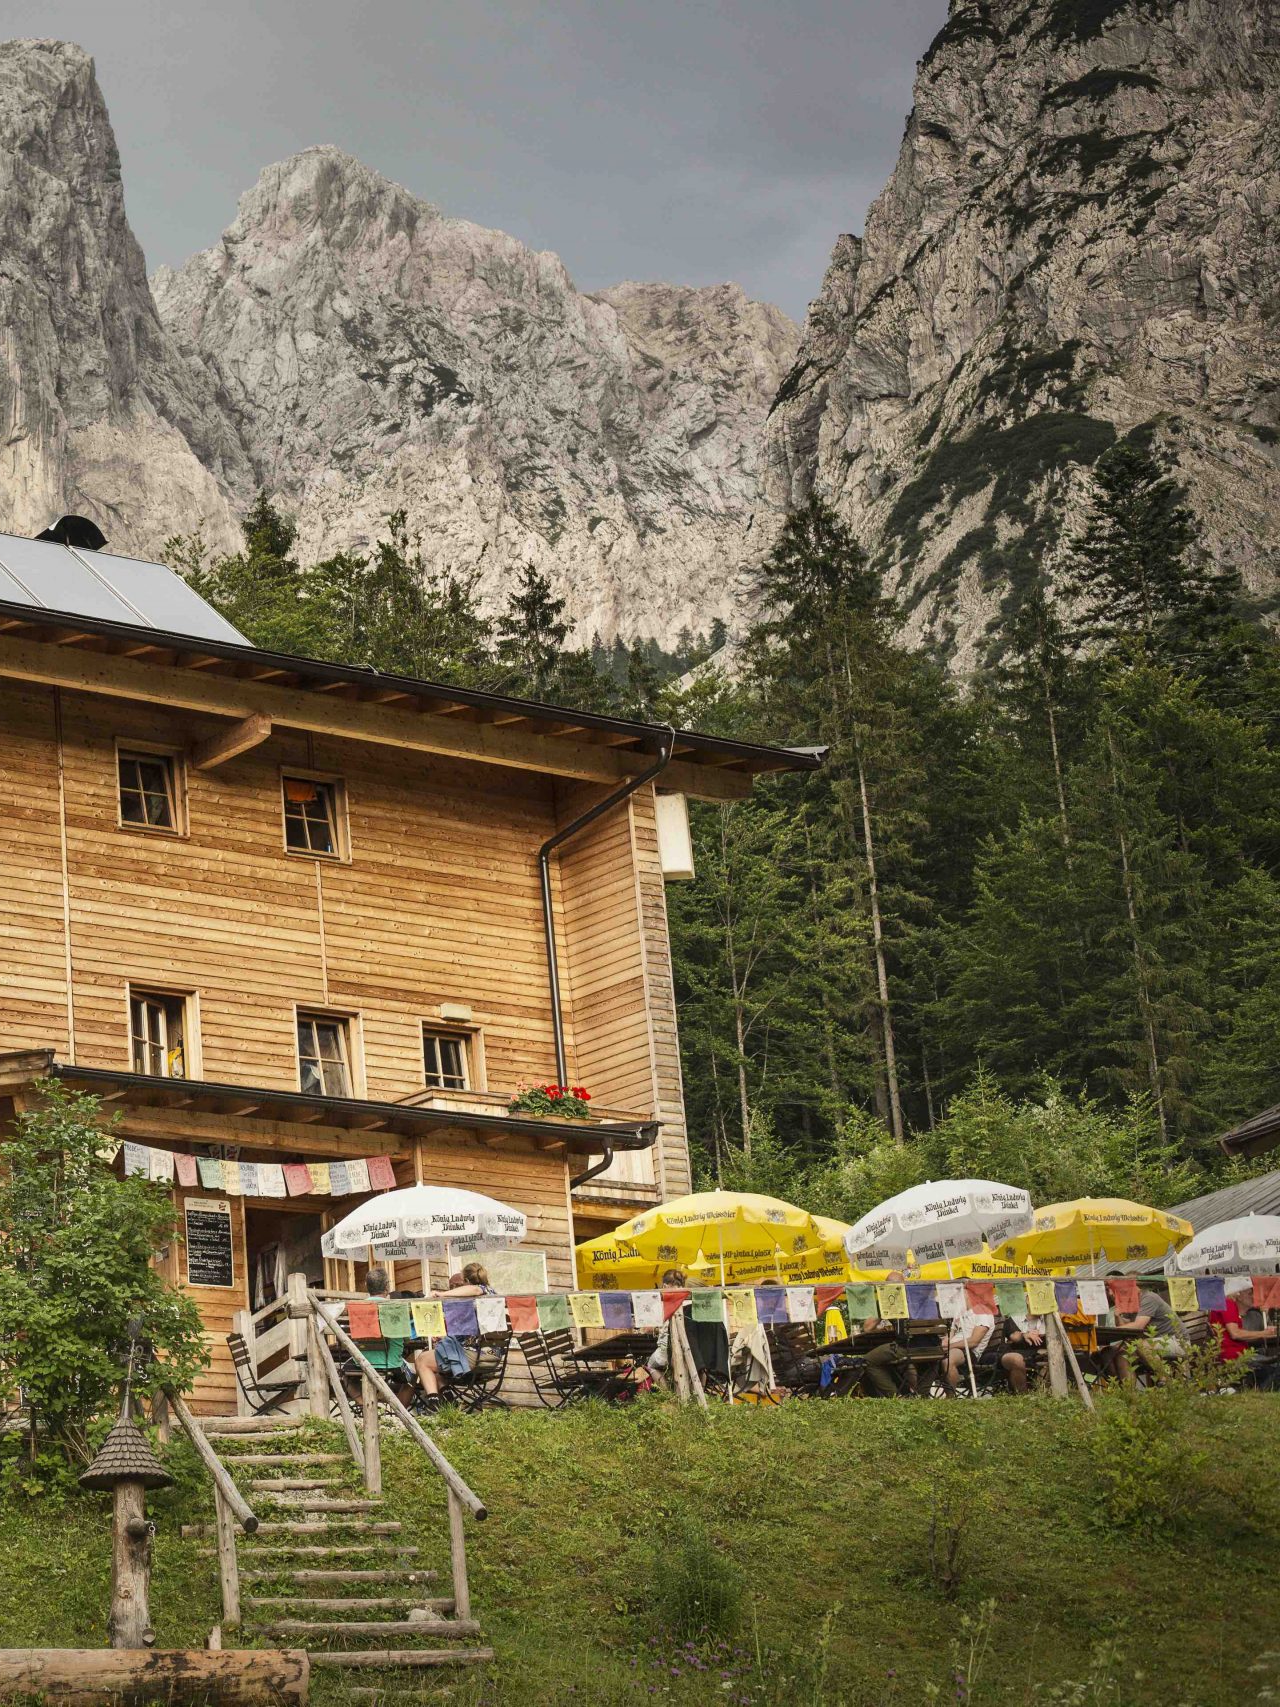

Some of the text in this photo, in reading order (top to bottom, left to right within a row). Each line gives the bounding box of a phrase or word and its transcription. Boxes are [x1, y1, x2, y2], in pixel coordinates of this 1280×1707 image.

[431, 1213, 475, 1225] König Ludwig
[592, 1249, 618, 1264] König
[972, 1263, 992, 1276] König
